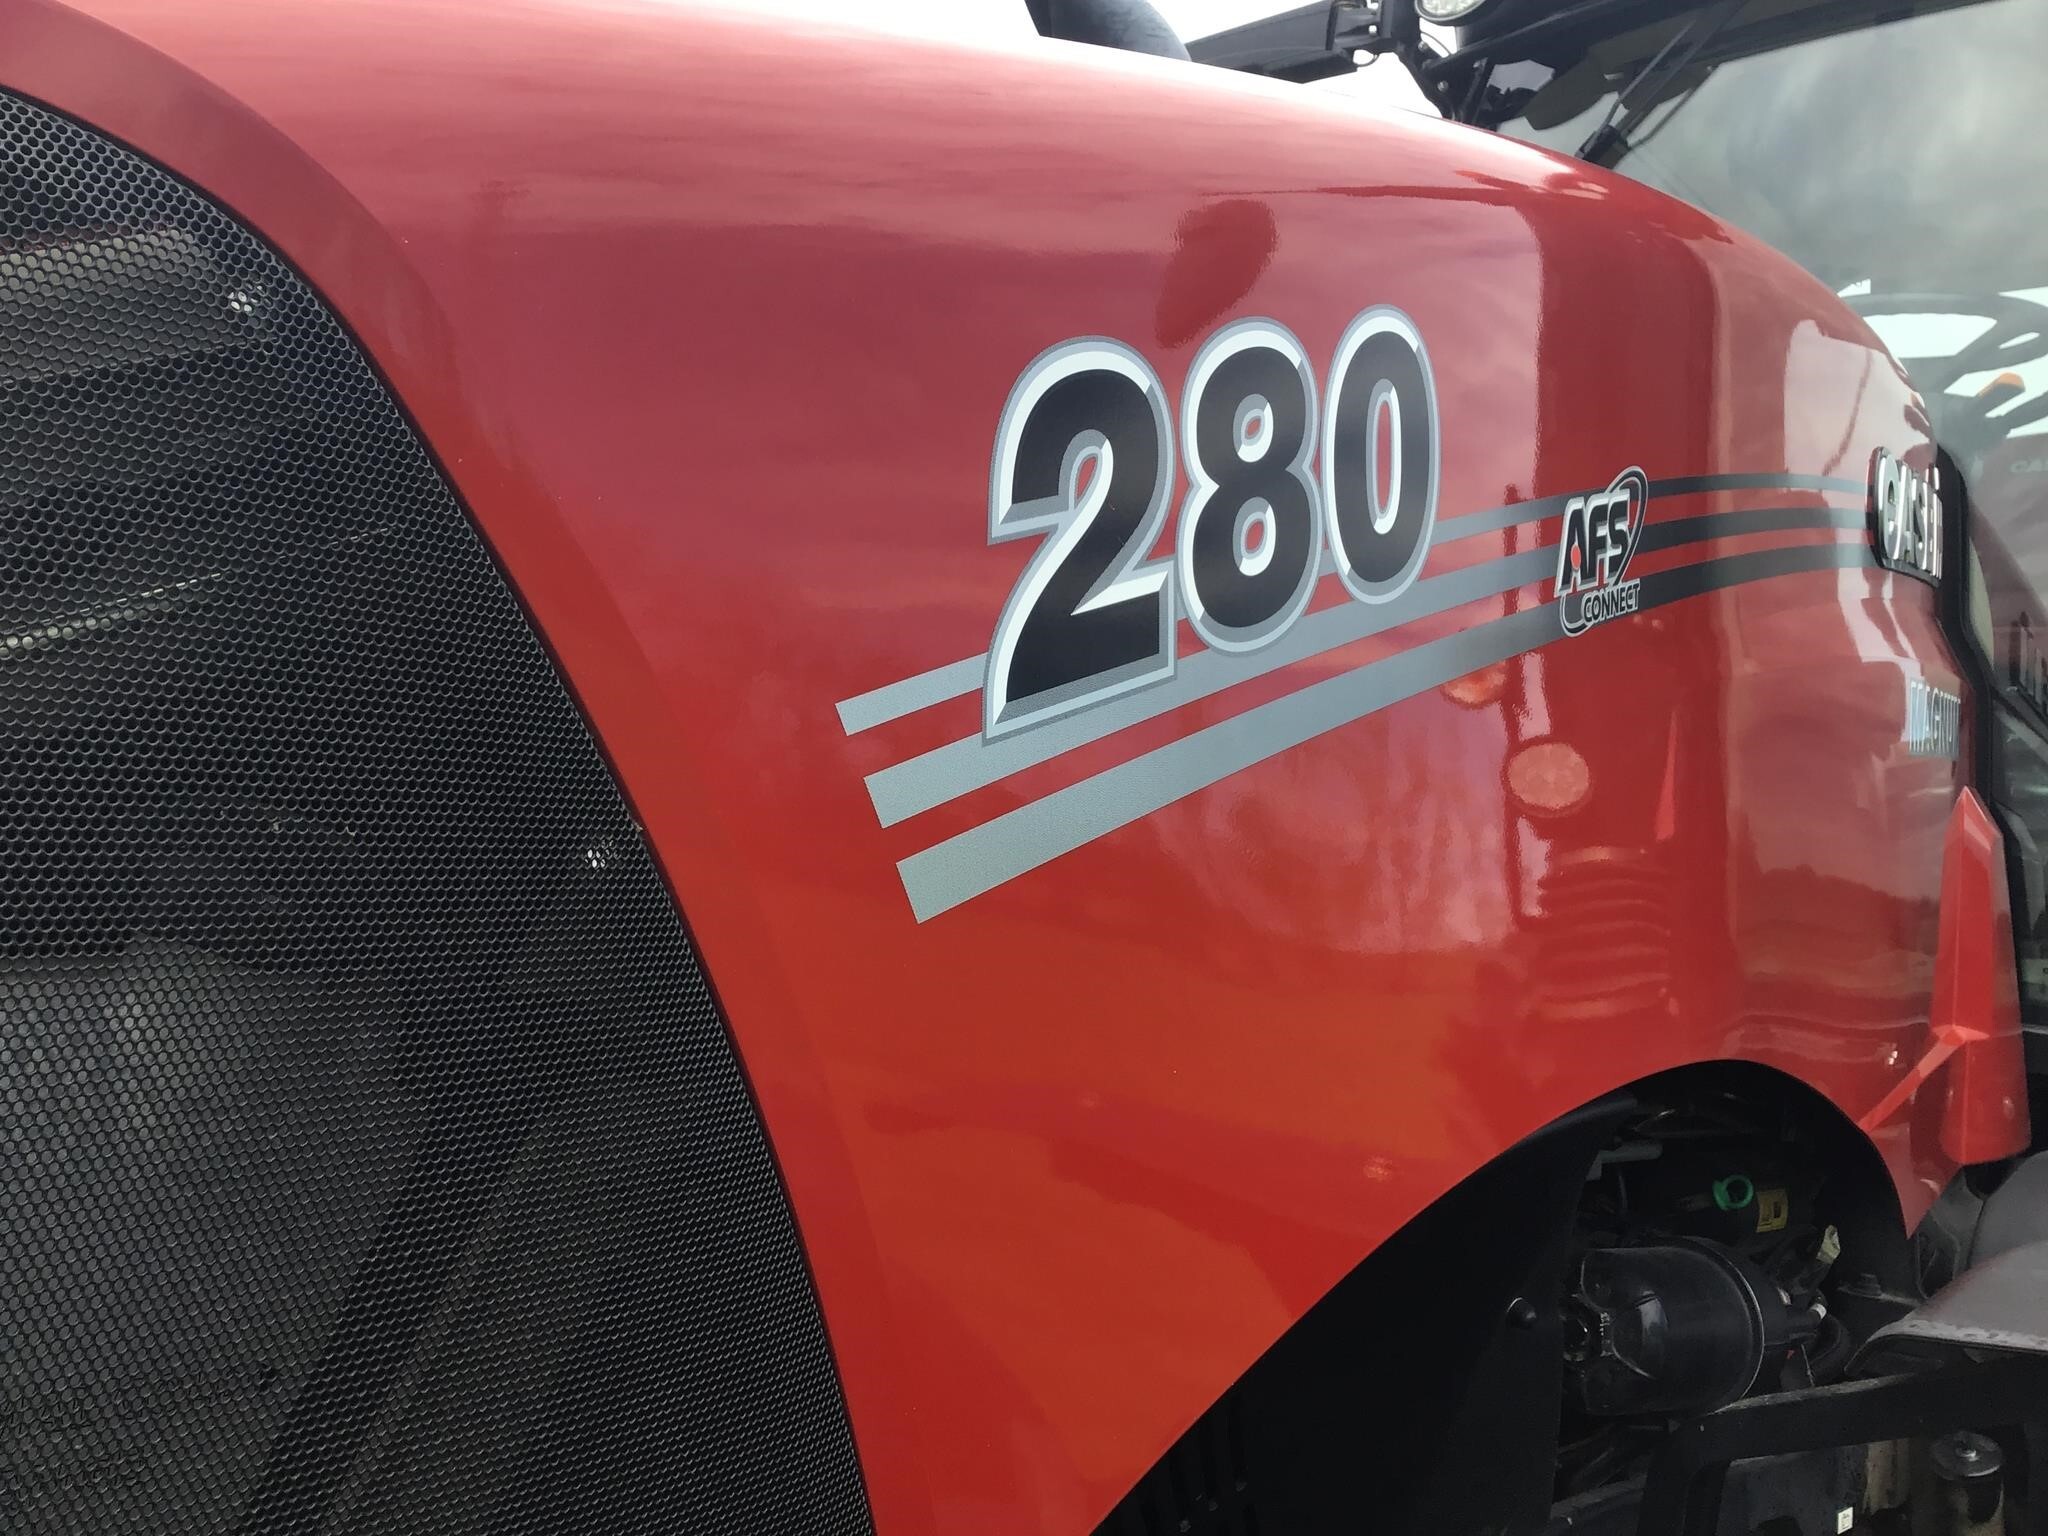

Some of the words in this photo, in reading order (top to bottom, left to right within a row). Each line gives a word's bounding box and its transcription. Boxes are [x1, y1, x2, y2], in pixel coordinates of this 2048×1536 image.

[983, 304, 1440, 745] 280
[1554, 489, 1631, 598] AFS
[1581, 580, 1640, 623] CONNECT
